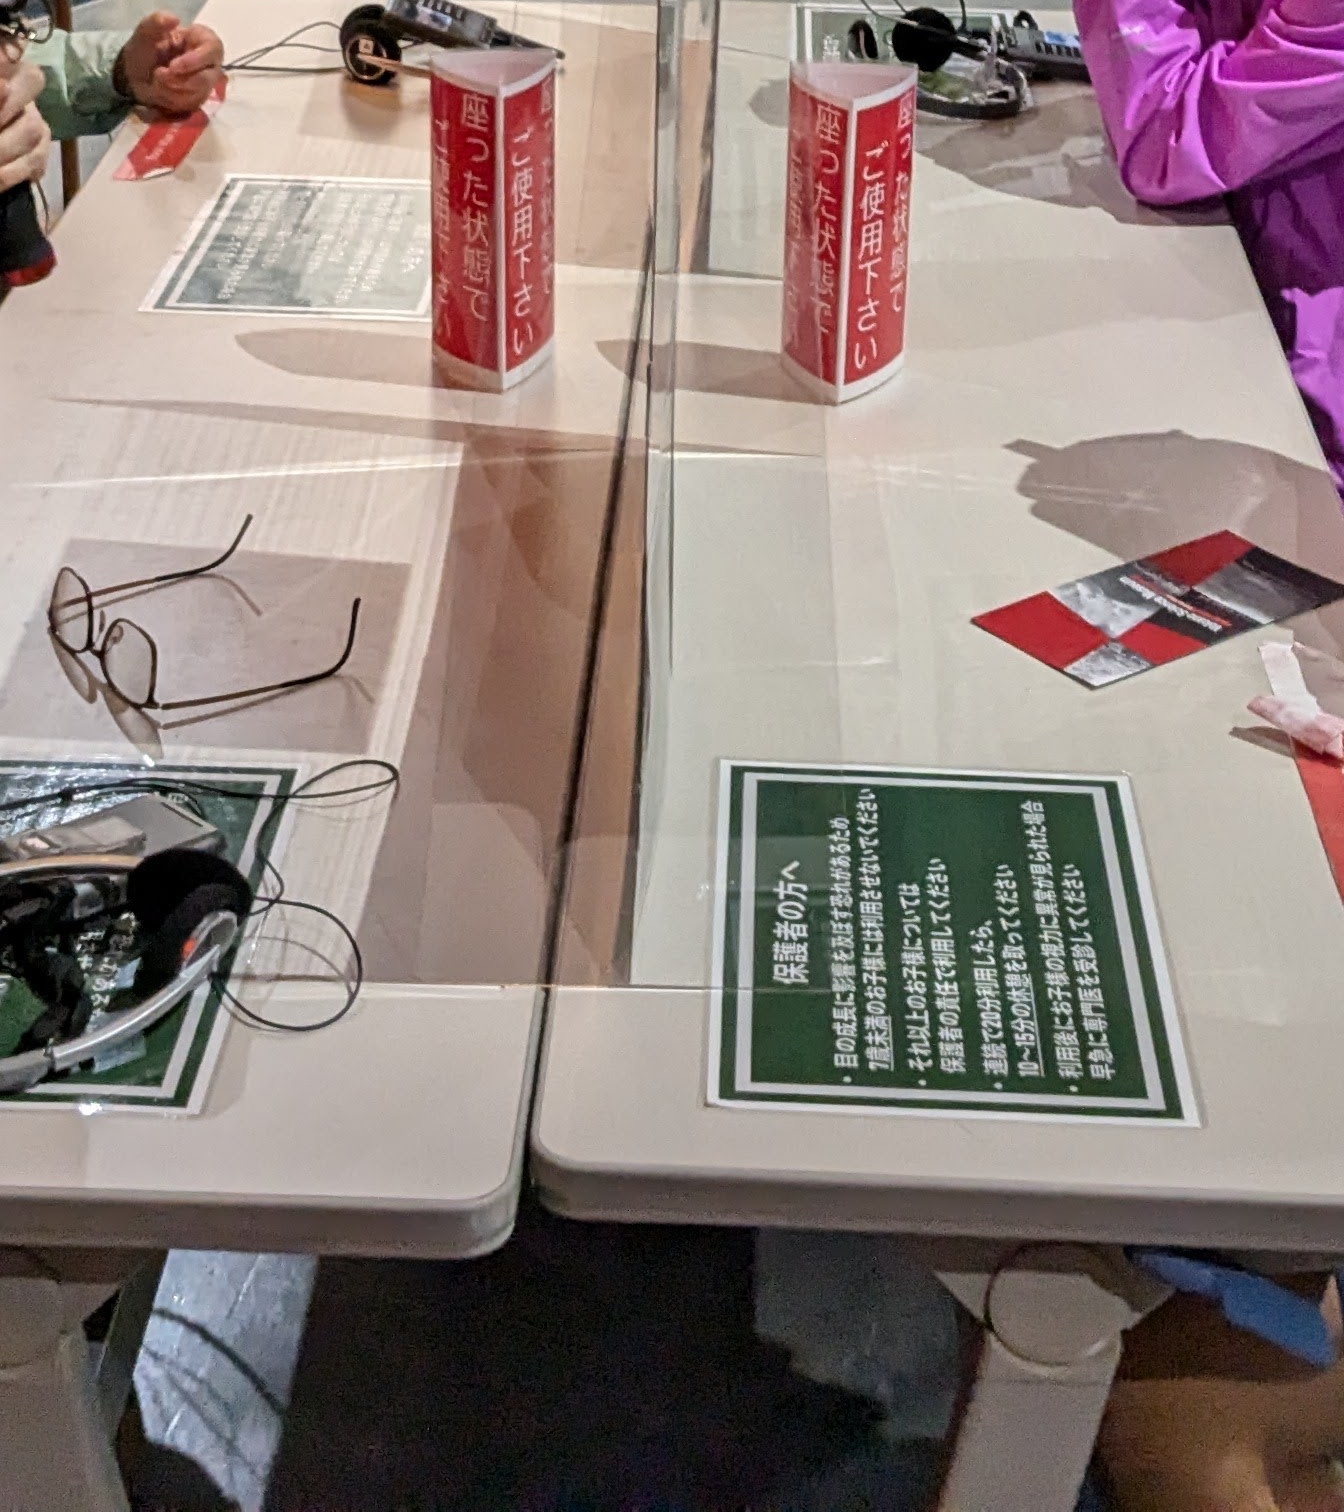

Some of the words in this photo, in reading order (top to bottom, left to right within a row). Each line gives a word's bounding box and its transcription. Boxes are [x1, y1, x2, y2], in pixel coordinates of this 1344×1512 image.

[460, 93, 491, 323] 座った状態で
[511, 128, 535, 357] ご使用下さい
[854, 140, 889, 370] ご使用下さい
[772, 859, 809, 985] 保護者の方へ
[897, 882, 933, 1072] それ以上のお子様については
[924, 857, 966, 1074] 保護者の責任で利用してください
[1058, 864, 1117, 1080] 早急に専門医を受診してください
